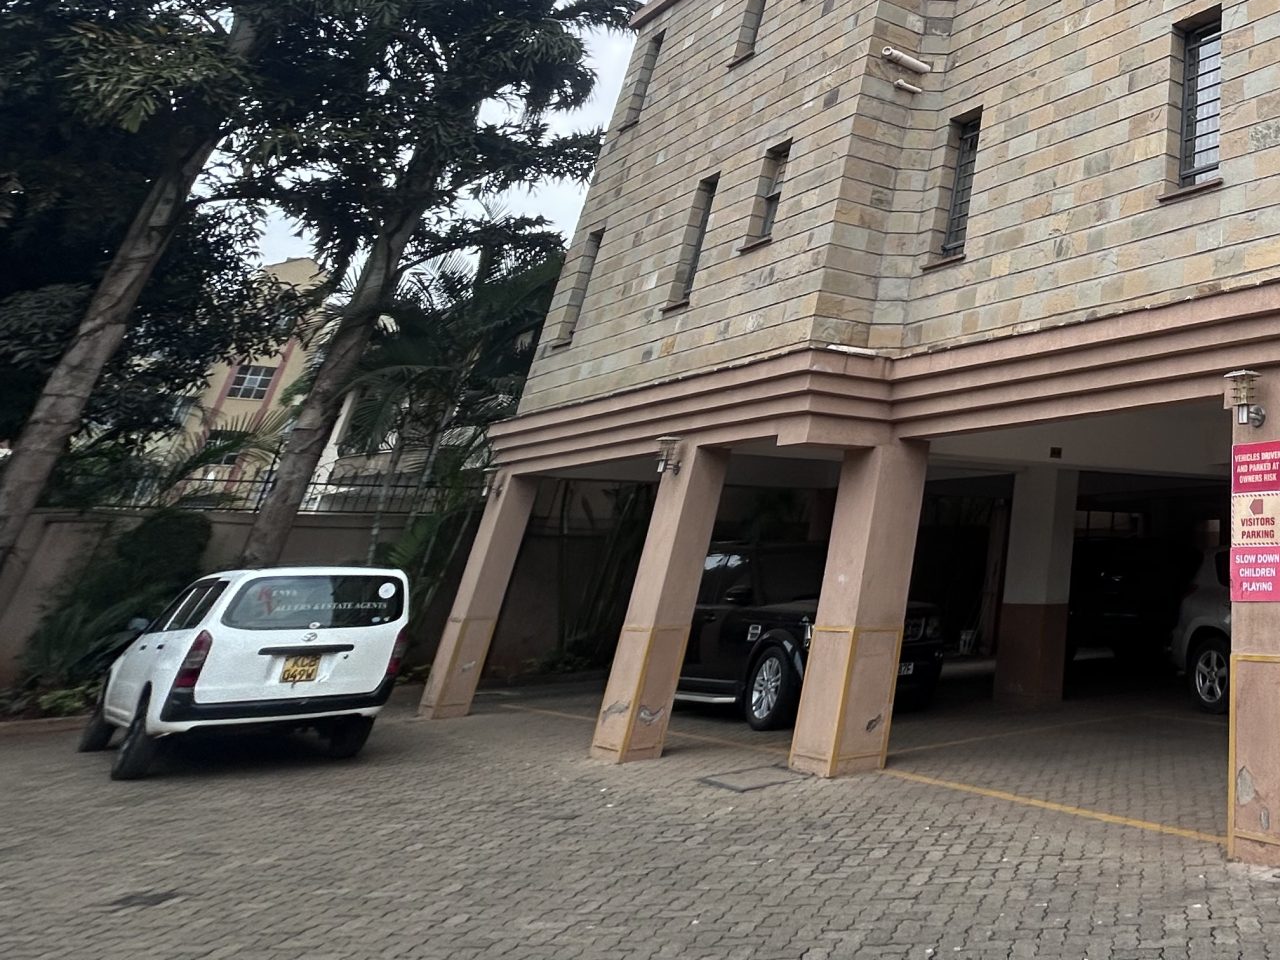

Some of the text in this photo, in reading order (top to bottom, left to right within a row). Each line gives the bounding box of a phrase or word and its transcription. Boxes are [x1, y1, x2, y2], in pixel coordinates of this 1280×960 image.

[1235, 452, 1260, 462] VEHICLES
[1237, 461, 1280, 473] AND PARKED AT
[1239, 473, 1277, 484] OWNERS RISK
[1241, 517, 1275, 527] VISITORS
[1241, 529, 1275, 539] PARKING
[1235, 554, 1280, 564] SLOW DOWN
[1239, 567, 1276, 578] CHILDREN
[1242, 581, 1273, 592] PLAYING
[320, 601, 353, 610] ESTATE
[354, 601, 388, 609] AGENTS
